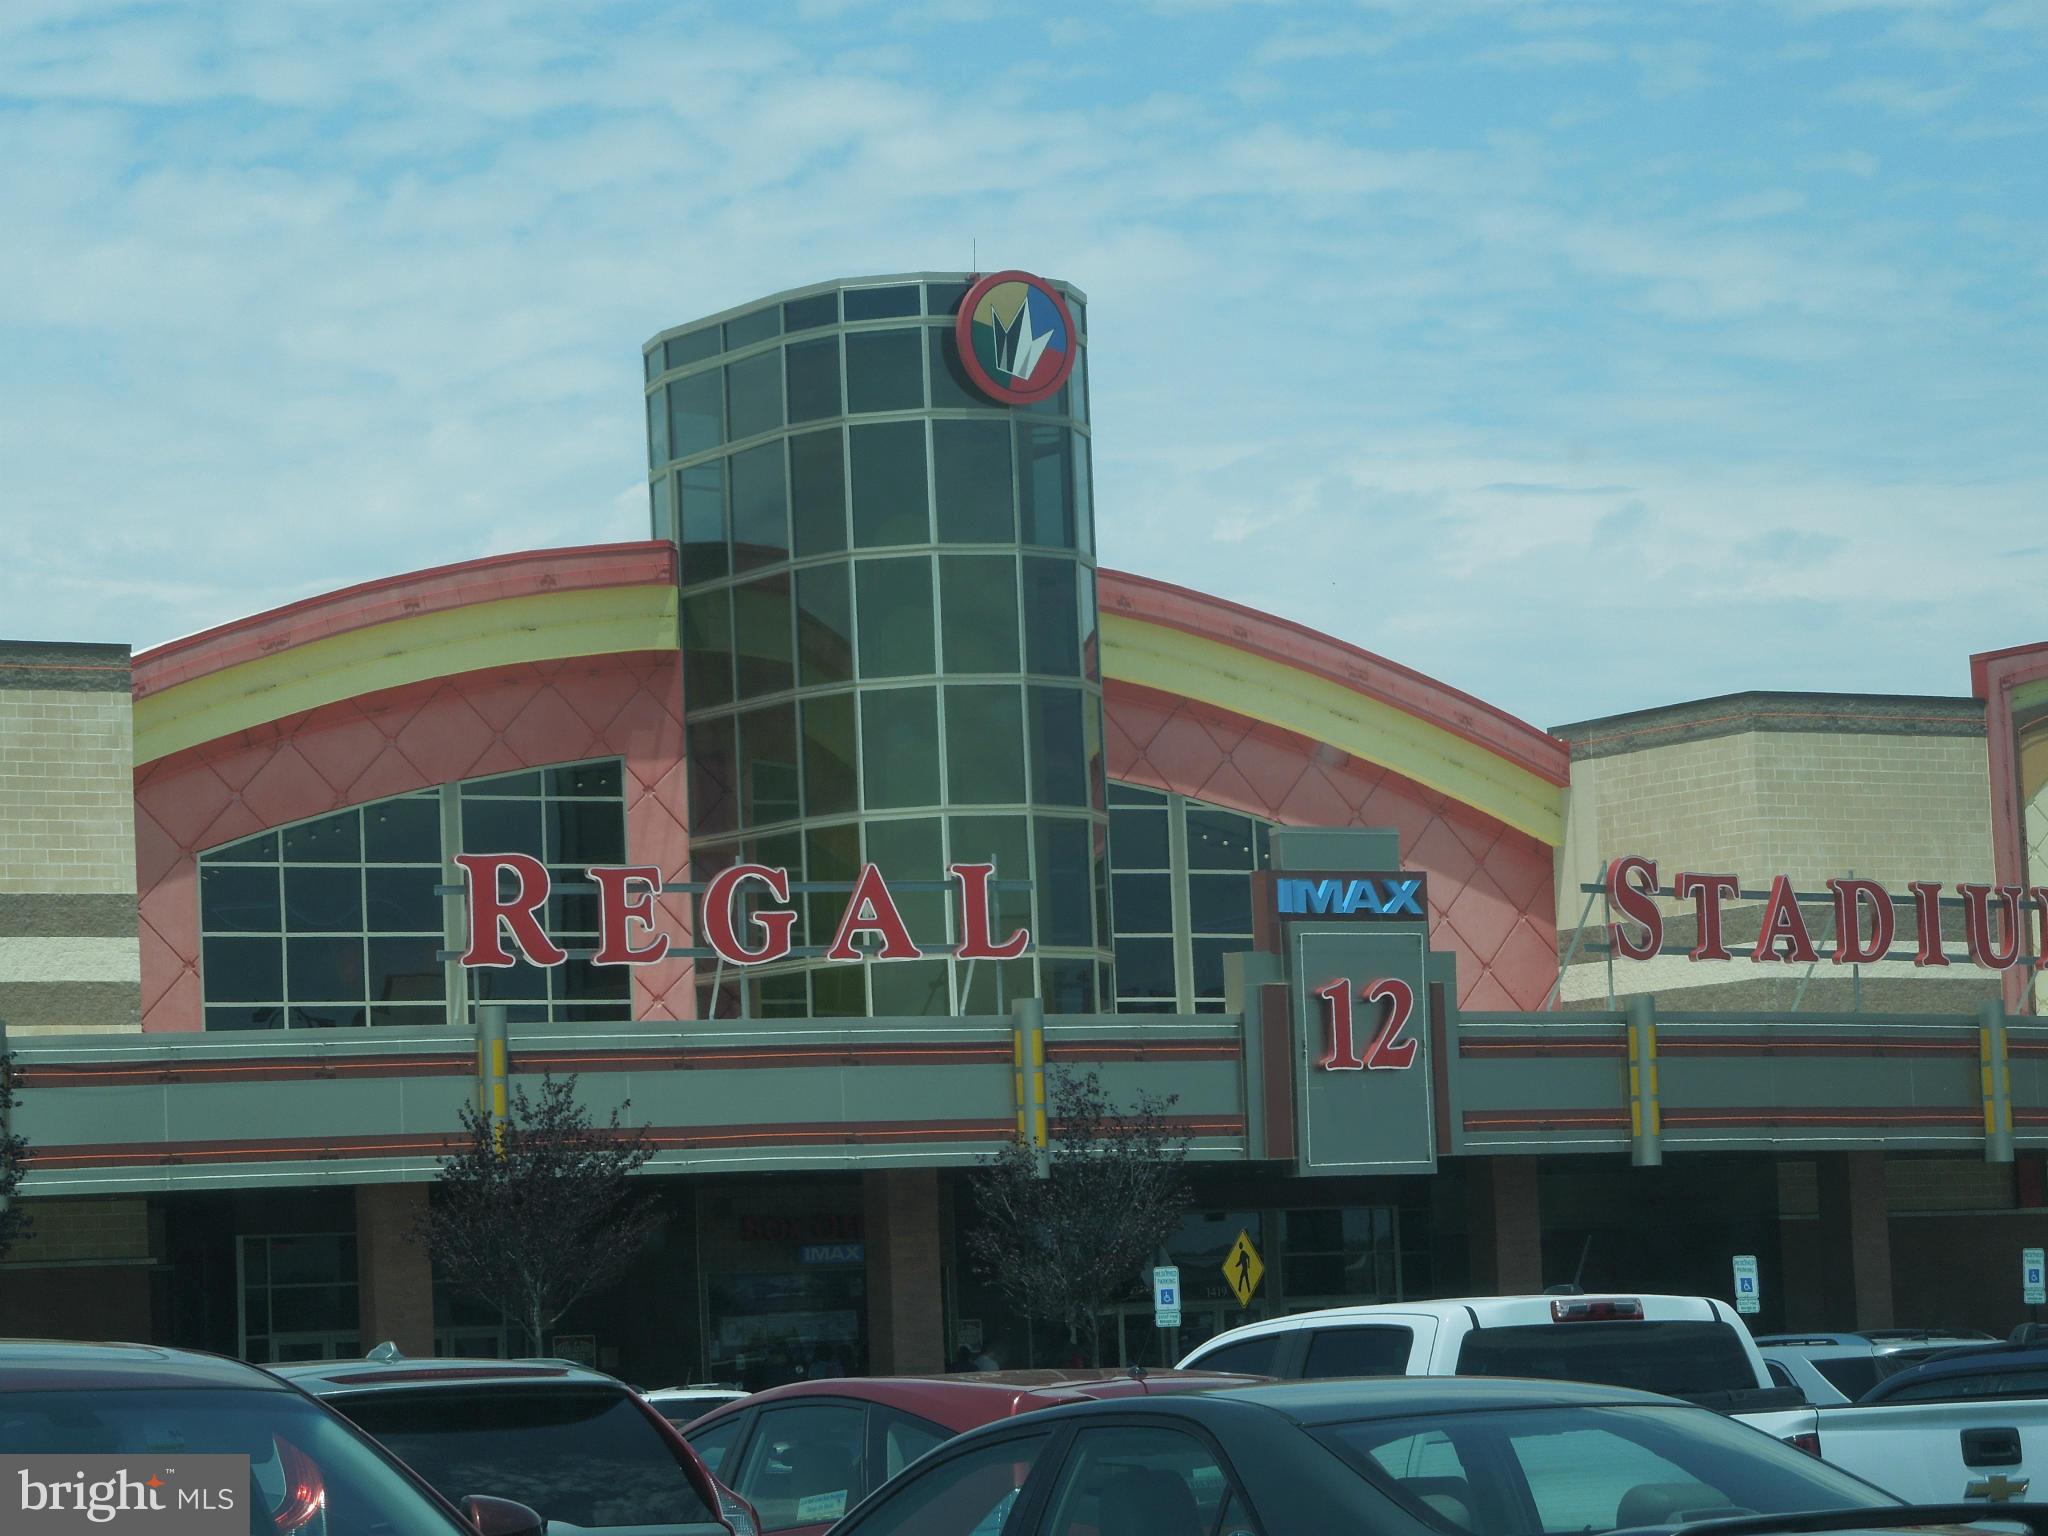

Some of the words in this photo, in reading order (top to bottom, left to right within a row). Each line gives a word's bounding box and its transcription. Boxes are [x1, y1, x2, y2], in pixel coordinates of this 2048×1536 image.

[453, 852, 1030, 968] REGAL
[1277, 877, 1424, 915] IMAX
[1605, 855, 2048, 970] STADIU
[1314, 976, 1418, 1073] 12
[804, 1246, 860, 1261] IMAX
